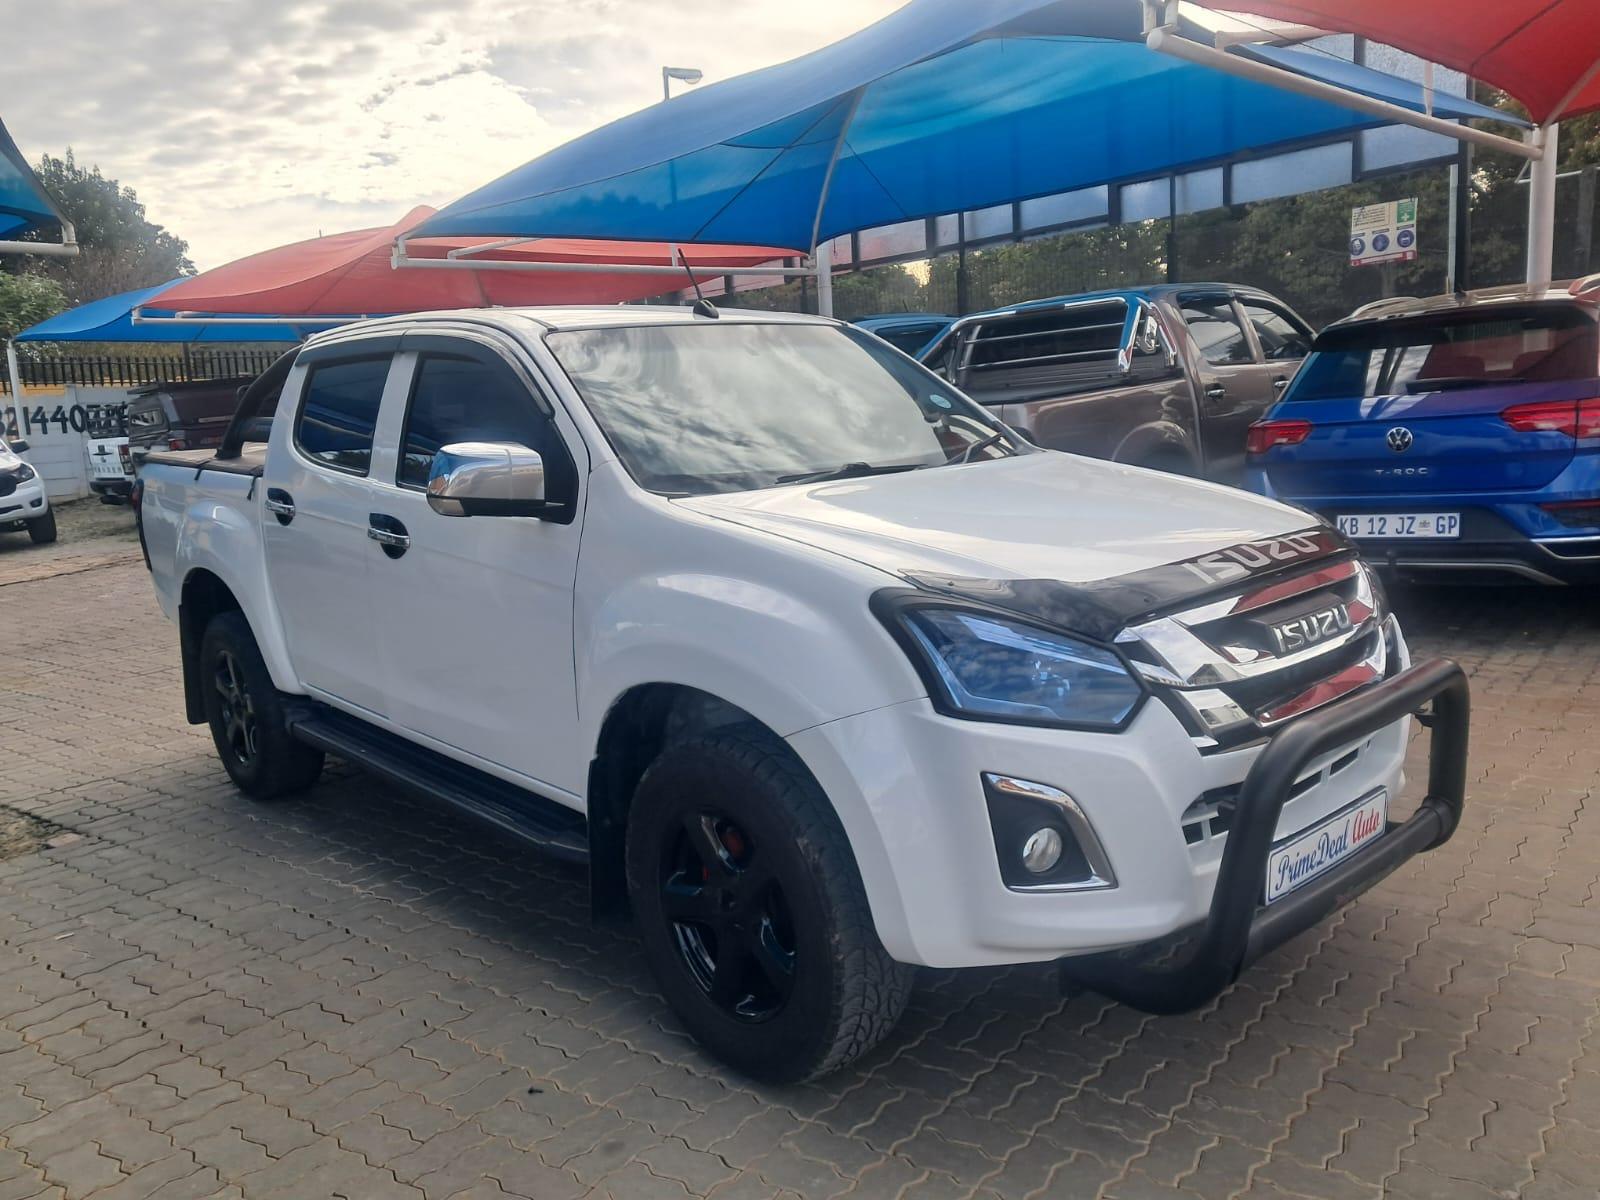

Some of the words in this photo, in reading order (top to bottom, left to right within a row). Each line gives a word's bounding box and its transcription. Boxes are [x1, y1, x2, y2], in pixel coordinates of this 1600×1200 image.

[1375, 467, 1429, 476] T-ROC
[1340, 517, 1358, 536] KB
[1367, 516, 1387, 535] 12
[1395, 516, 1416, 535] JZ
[1436, 515, 1457, 534] GP
[1183, 531, 1320, 584] ISUZU
[1272, 604, 1350, 652] ISUZU
[1352, 808, 1381, 844] Auto
